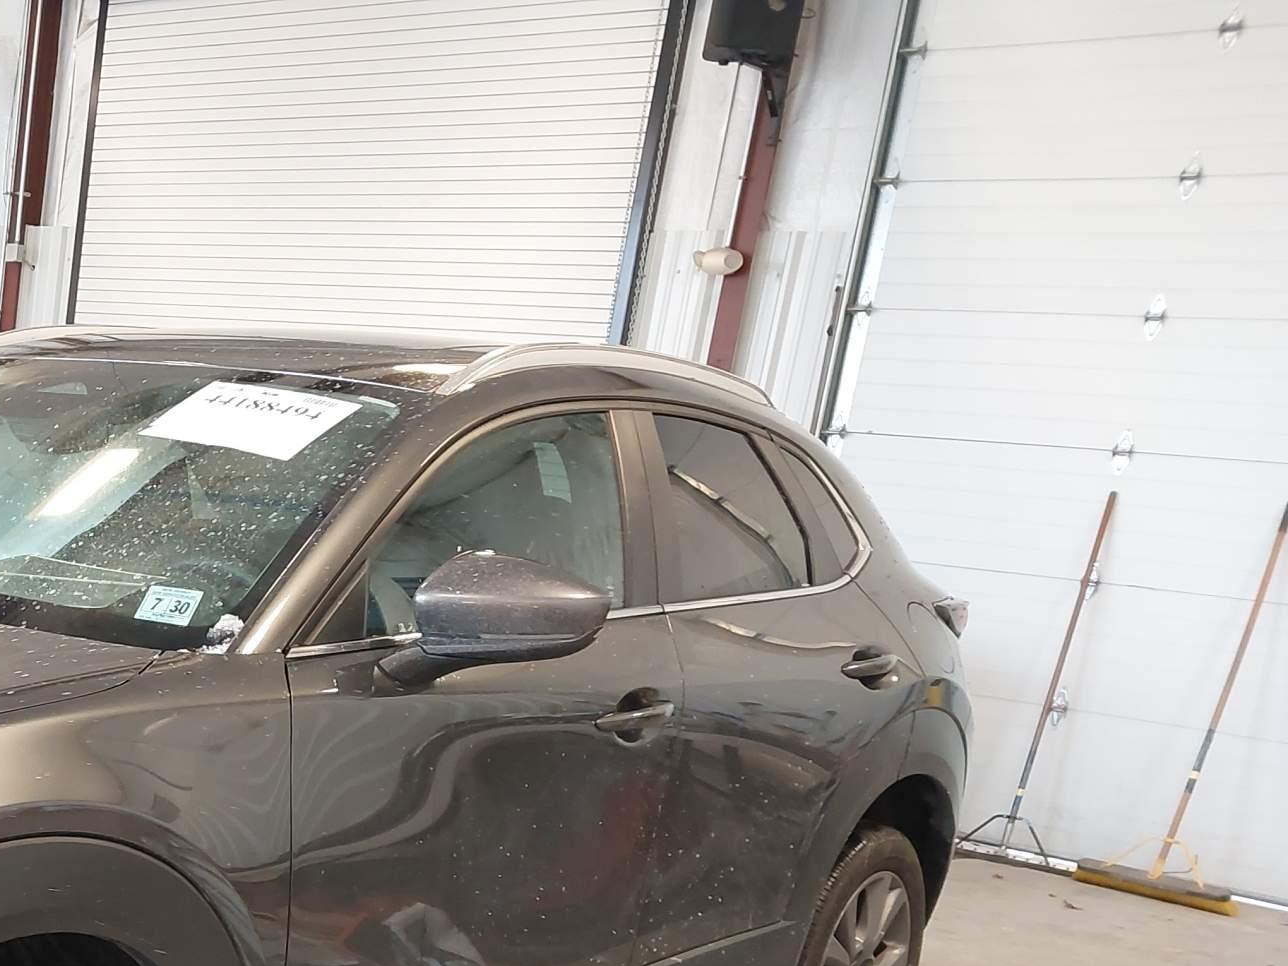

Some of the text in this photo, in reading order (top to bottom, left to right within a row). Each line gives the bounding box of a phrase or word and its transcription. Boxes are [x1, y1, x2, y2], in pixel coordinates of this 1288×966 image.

[205, 395, 322, 420] 44188494
[150, 598, 190, 614] 7 30
